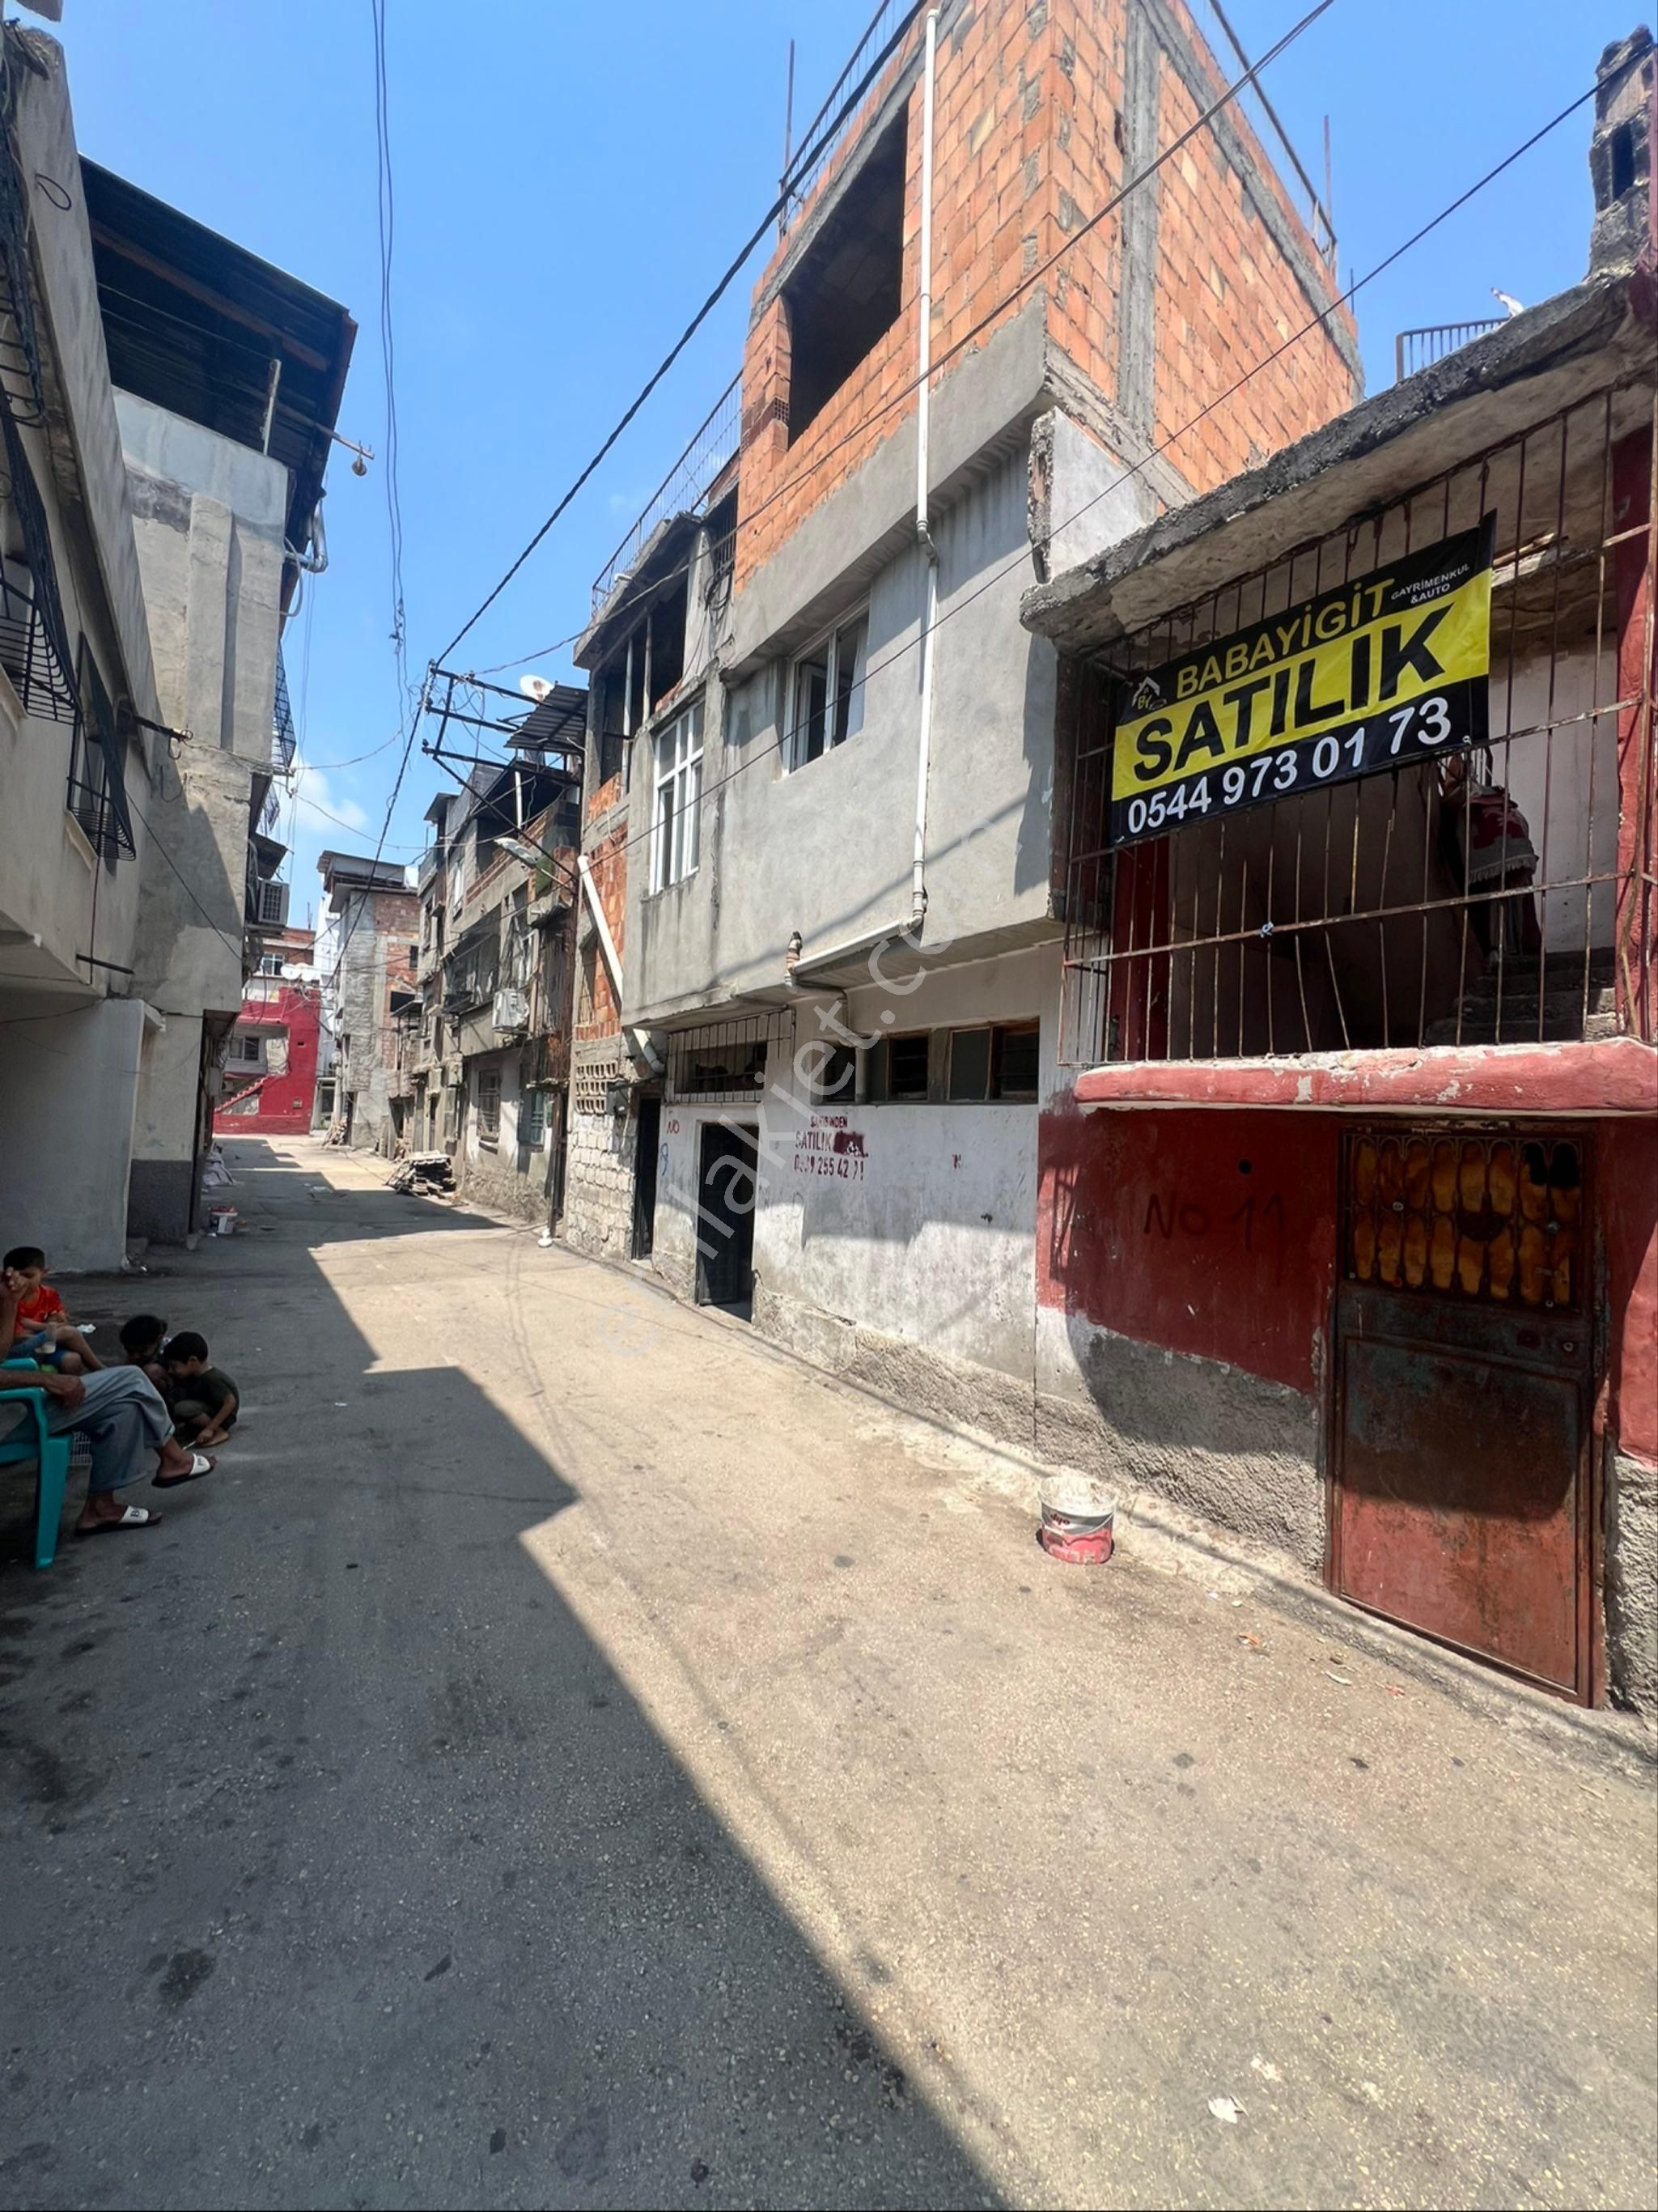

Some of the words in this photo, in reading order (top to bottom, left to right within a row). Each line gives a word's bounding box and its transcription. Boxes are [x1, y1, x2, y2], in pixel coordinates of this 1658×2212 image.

[1391, 563, 1469, 601] GAYRİMENKUL
[1410, 584, 1450, 604] &AUTO
[1176, 578, 1395, 699] BABAYİGİT
[1133, 601, 1457, 782] SATILIK
[1128, 778, 1212, 834] 0544
[1223, 750, 1297, 805] 973
[1312, 727, 1366, 779] 01
[1389, 697, 1452, 754] 73
[818, 1157, 834, 1177] 255
[837, 1158, 849, 1178] 42
[1230, 1191, 1287, 1279] 11
